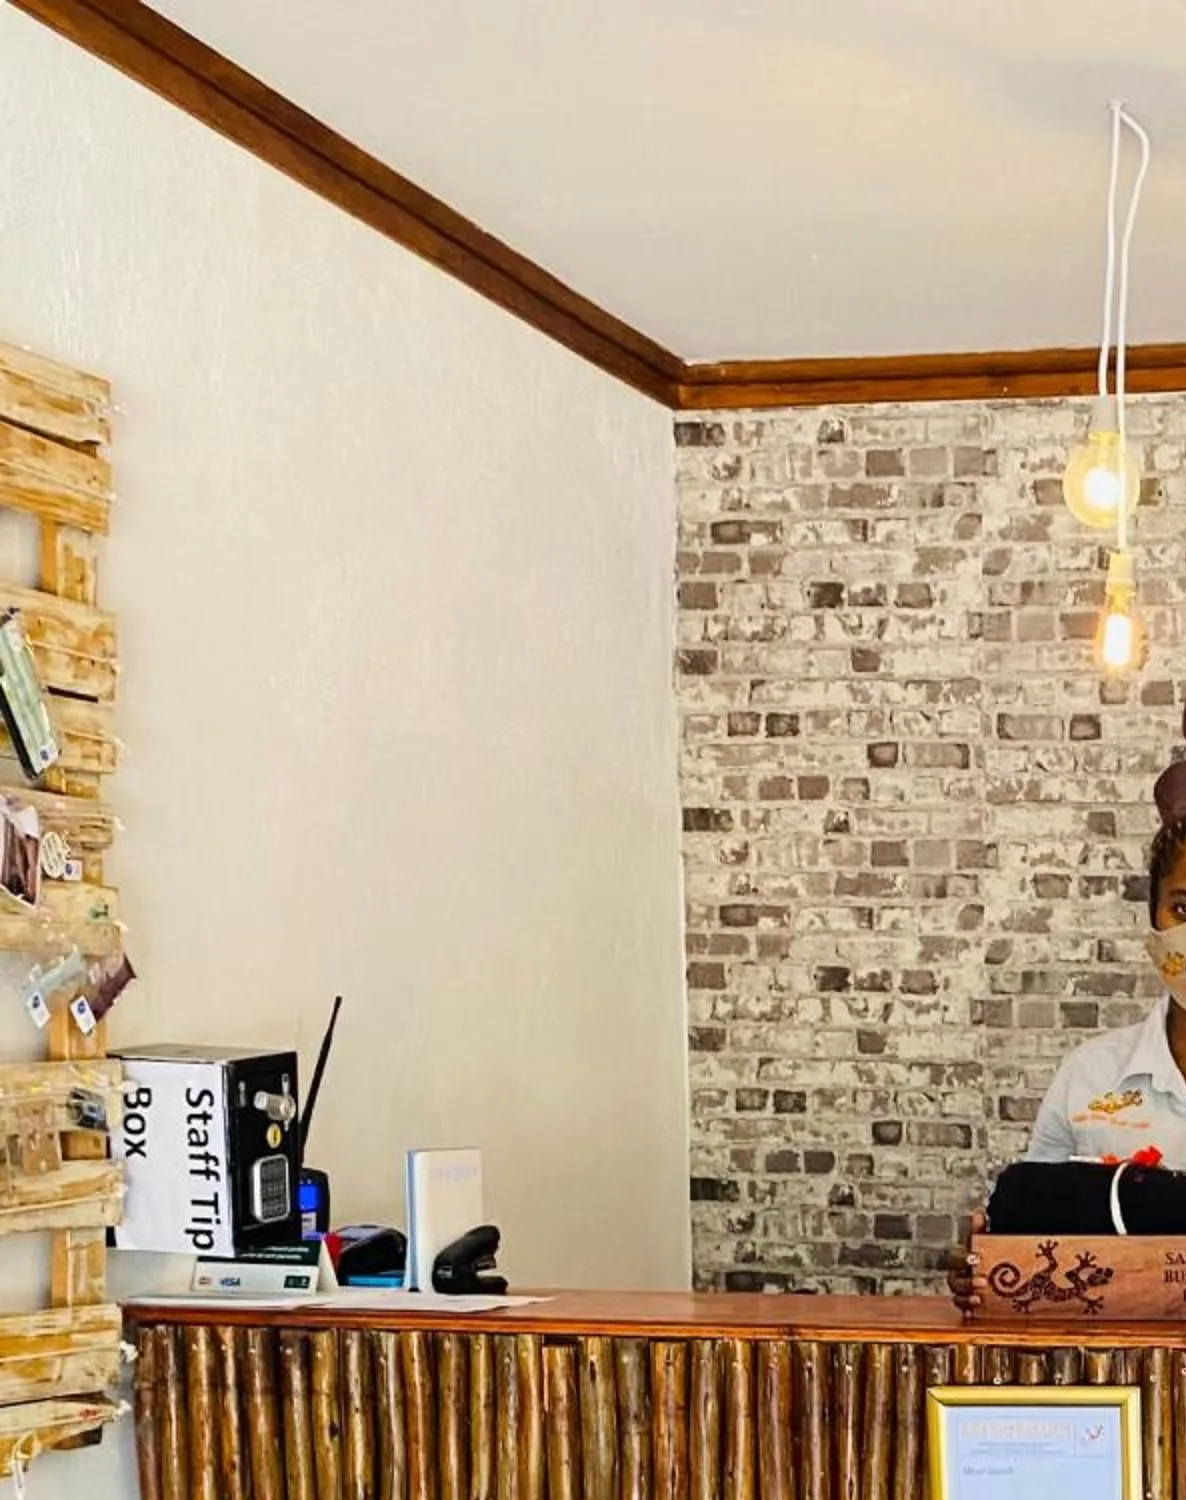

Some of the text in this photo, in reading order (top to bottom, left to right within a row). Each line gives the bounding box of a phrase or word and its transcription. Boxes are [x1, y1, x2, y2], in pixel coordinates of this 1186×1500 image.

[123, 1087, 152, 1159] Box
[184, 1087, 221, 1250] Staff Tip
